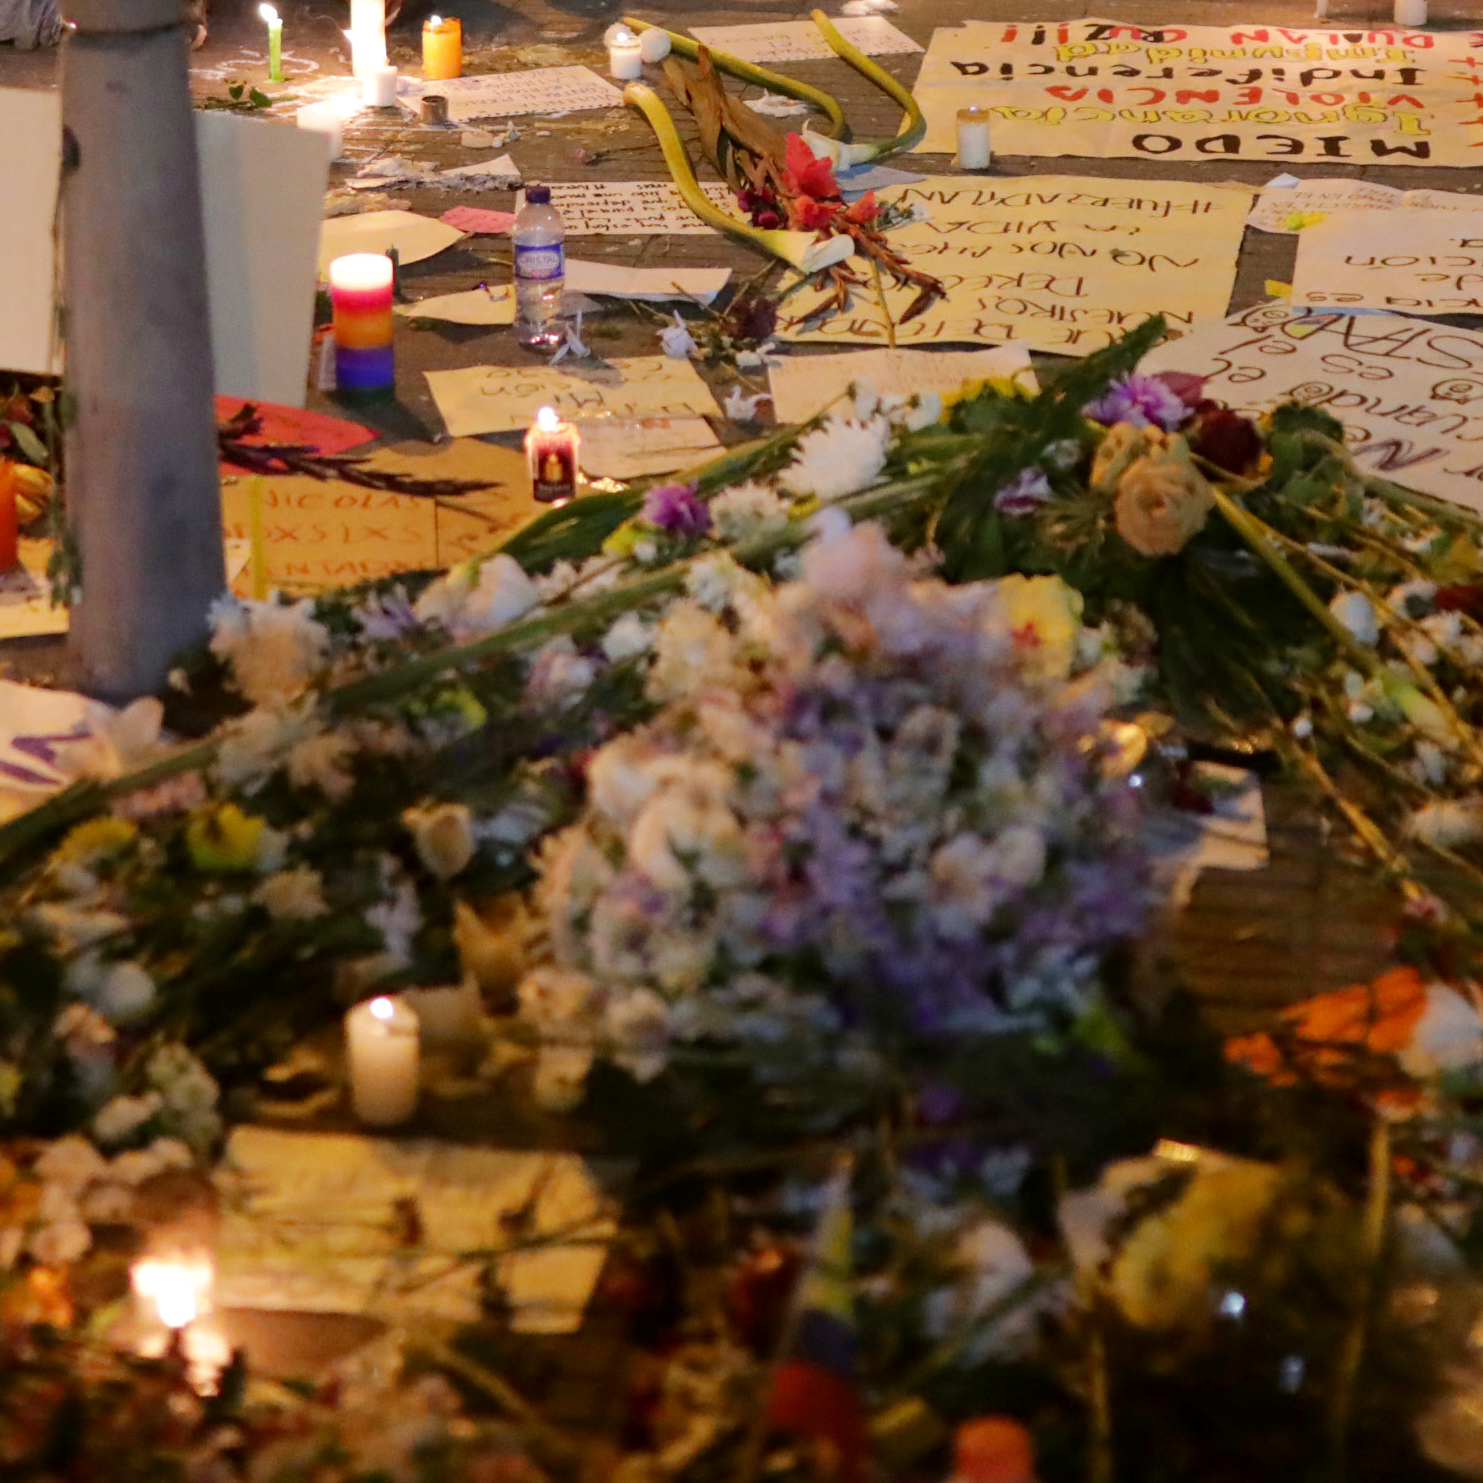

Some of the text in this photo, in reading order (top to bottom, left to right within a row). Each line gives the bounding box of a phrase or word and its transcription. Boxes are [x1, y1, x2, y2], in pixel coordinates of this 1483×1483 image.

[1052, 43, 1415, 63] Impunidad
[950, 61, 1427, 89] Indiferencia
[1044, 86, 1426, 110] VIOLENCIA
[989, 104, 1432, 136] Ignorancia
[1131, 133, 1432, 160] MIEDO
[926, 220, 1057, 235] VIDA
[1304, 291, 1366, 303] es
[1216, 332, 1297, 357] el
[1320, 355, 1394, 384] es
